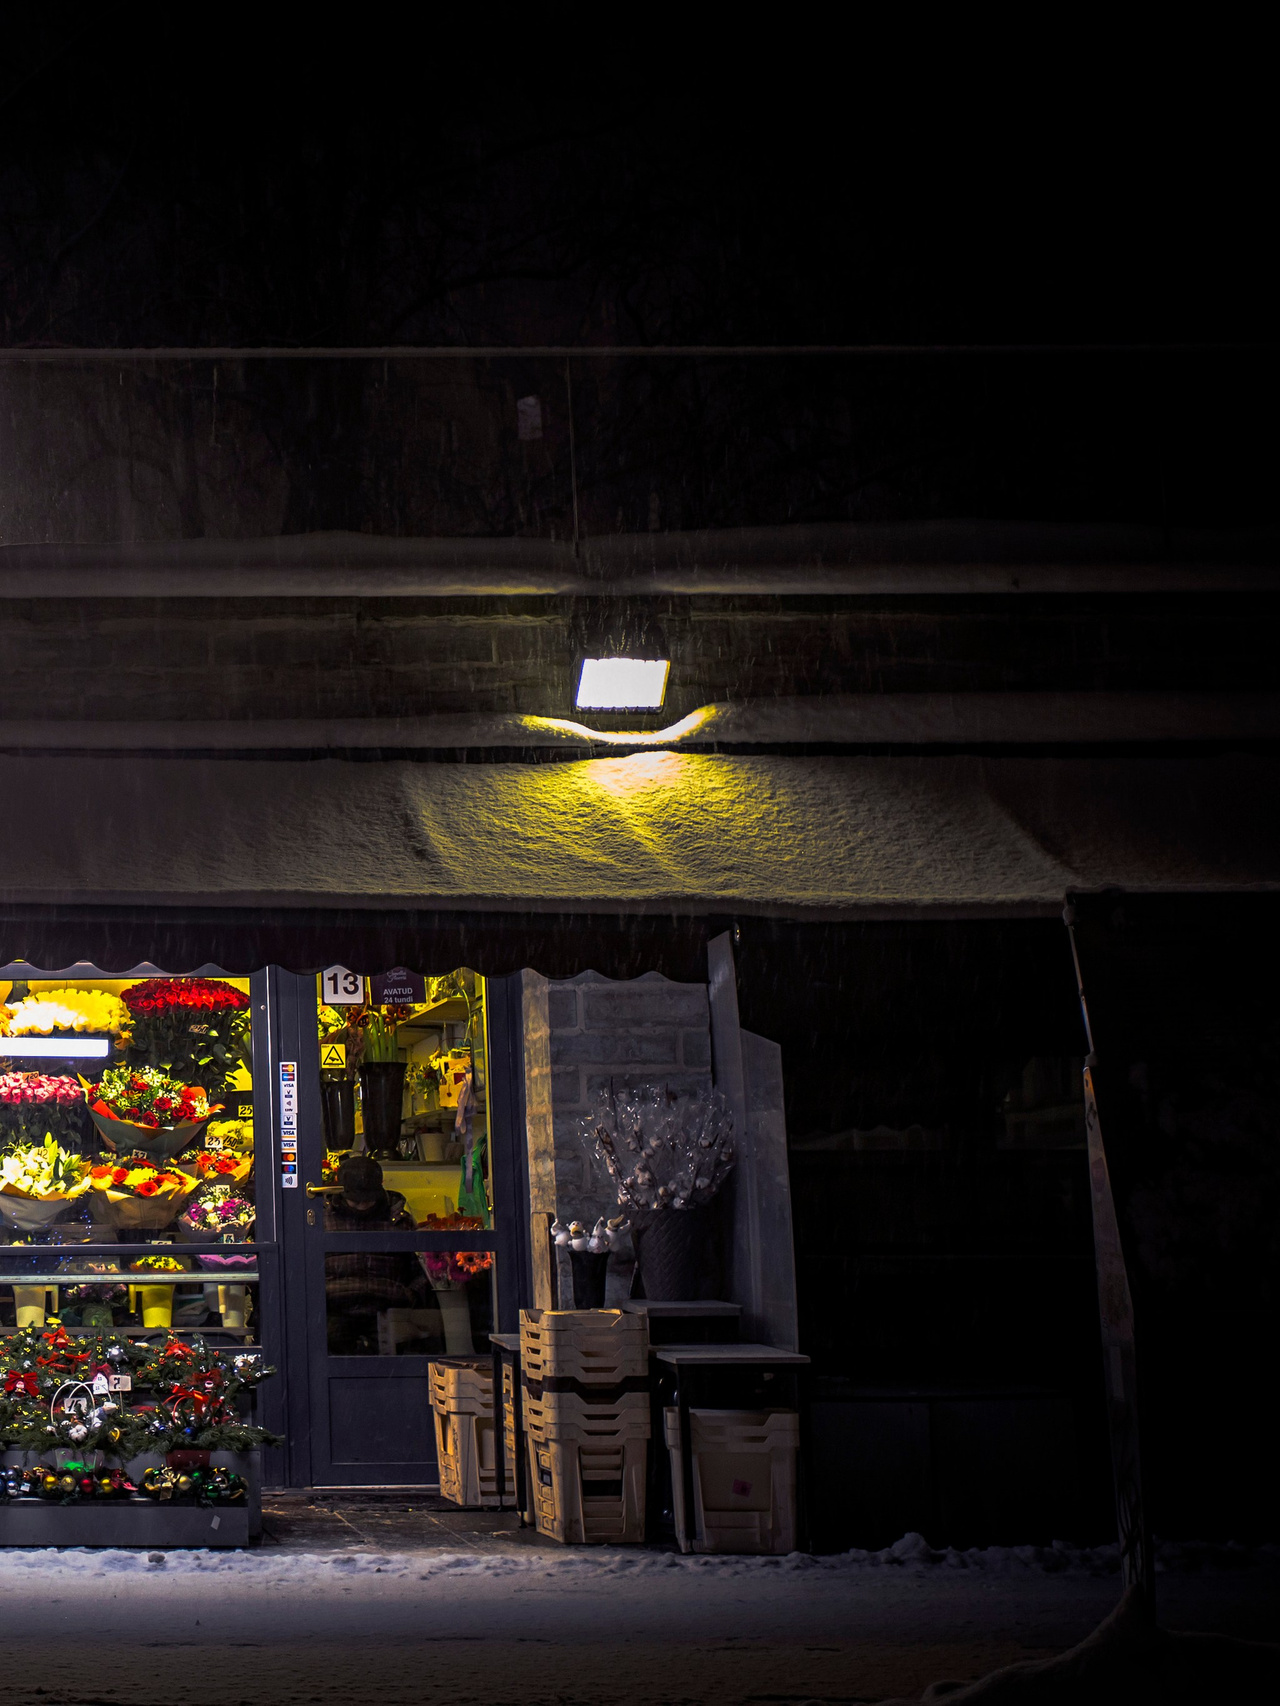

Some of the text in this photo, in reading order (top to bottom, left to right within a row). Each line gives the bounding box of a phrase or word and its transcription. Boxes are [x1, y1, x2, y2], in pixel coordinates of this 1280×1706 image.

[327, 973, 360, 995] 13
[383, 987, 413, 996] AVATUD
[384, 996, 413, 1004] 24 tundi
